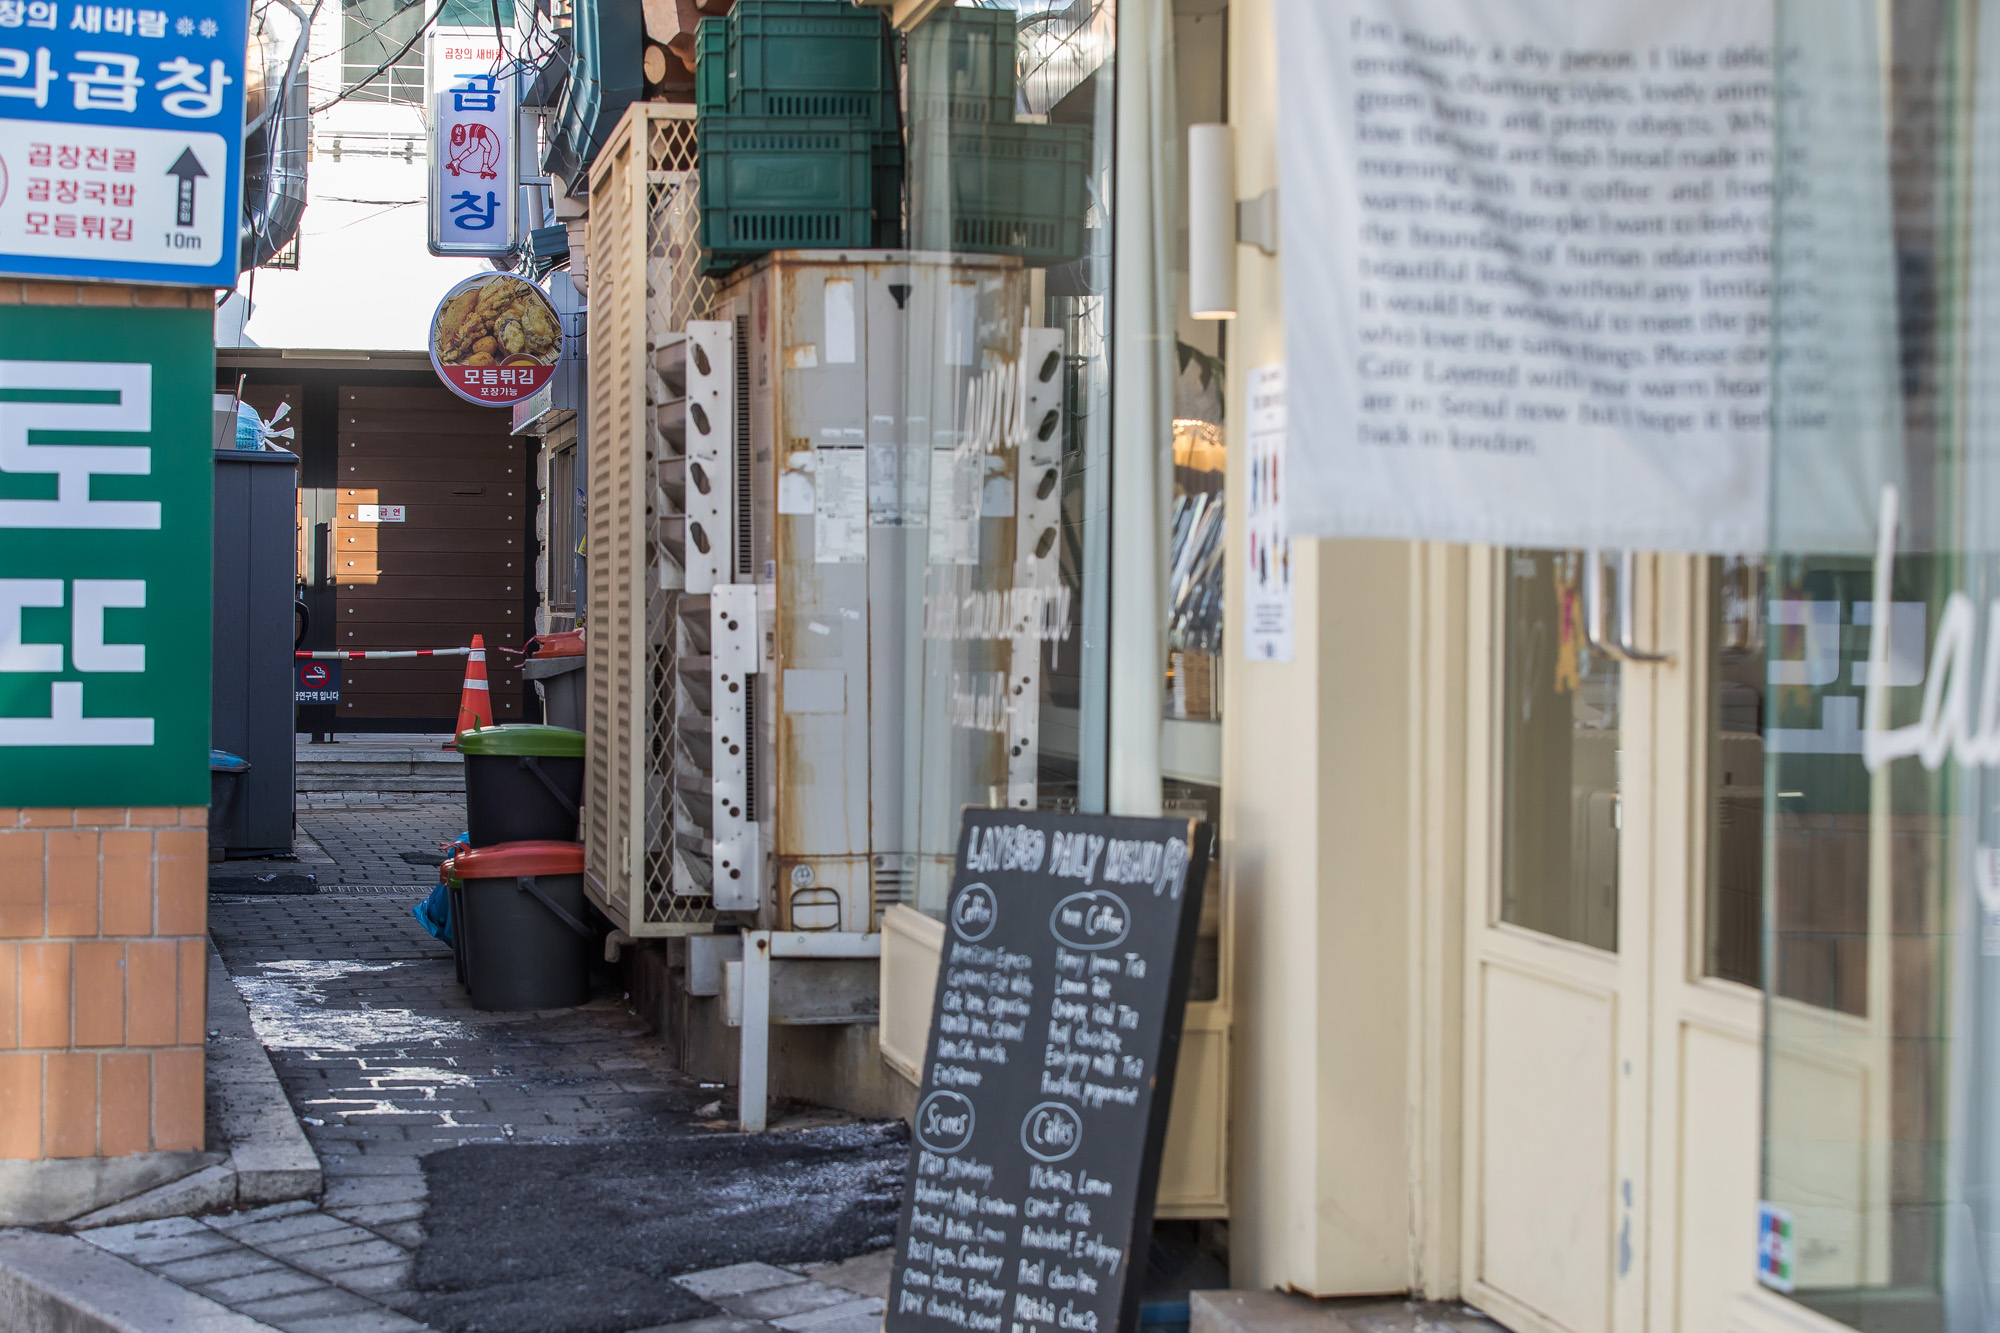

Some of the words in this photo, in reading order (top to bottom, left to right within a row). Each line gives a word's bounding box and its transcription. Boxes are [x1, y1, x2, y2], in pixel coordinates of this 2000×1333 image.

[70, 5, 167, 39] 새바람
[445, 47, 472, 60] 곱창의
[28, 142, 136, 173] 곱창전골
[27, 177, 136, 207] 곱창국밥
[25, 212, 133, 242] 모듬튀김
[165, 230, 202, 250] 10m
[463, 368, 534, 385] 모듬튀김
[480, 386, 518, 397] 포장가능
[320, 691, 339, 701] 입니다
